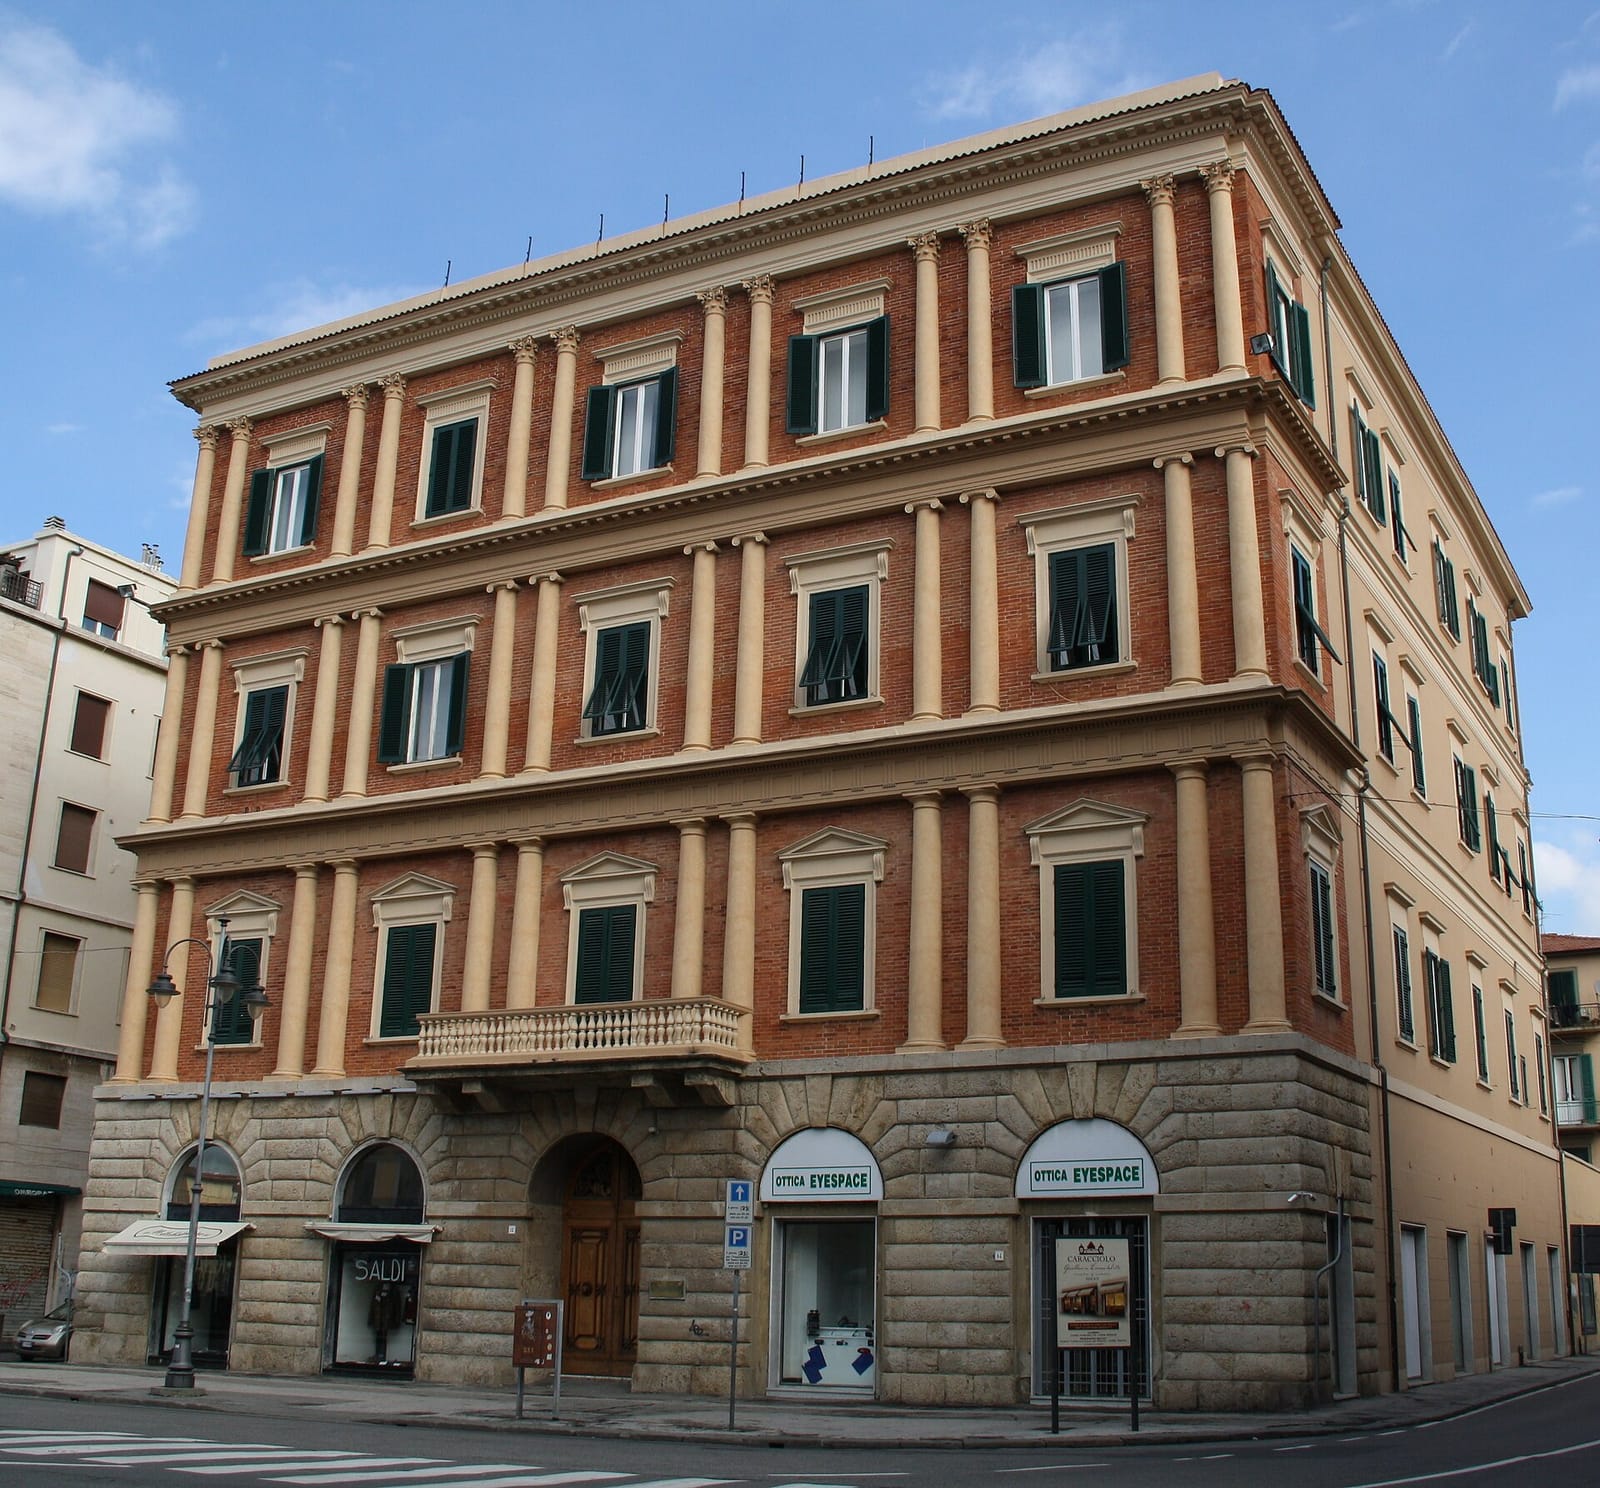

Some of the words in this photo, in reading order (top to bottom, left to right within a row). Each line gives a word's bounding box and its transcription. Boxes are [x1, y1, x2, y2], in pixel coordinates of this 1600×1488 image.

[775, 1175, 806, 1187] OTTICA
[810, 1173, 868, 1188] EYESPACE
[1034, 1169, 1068, 1182] OTTICA
[1073, 1166, 1140, 1183] EYESPACE
[732, 1230, 744, 1245] P
[1067, 1255, 1116, 1263] CARACCIOLO
[355, 1258, 405, 1282] SALDI
